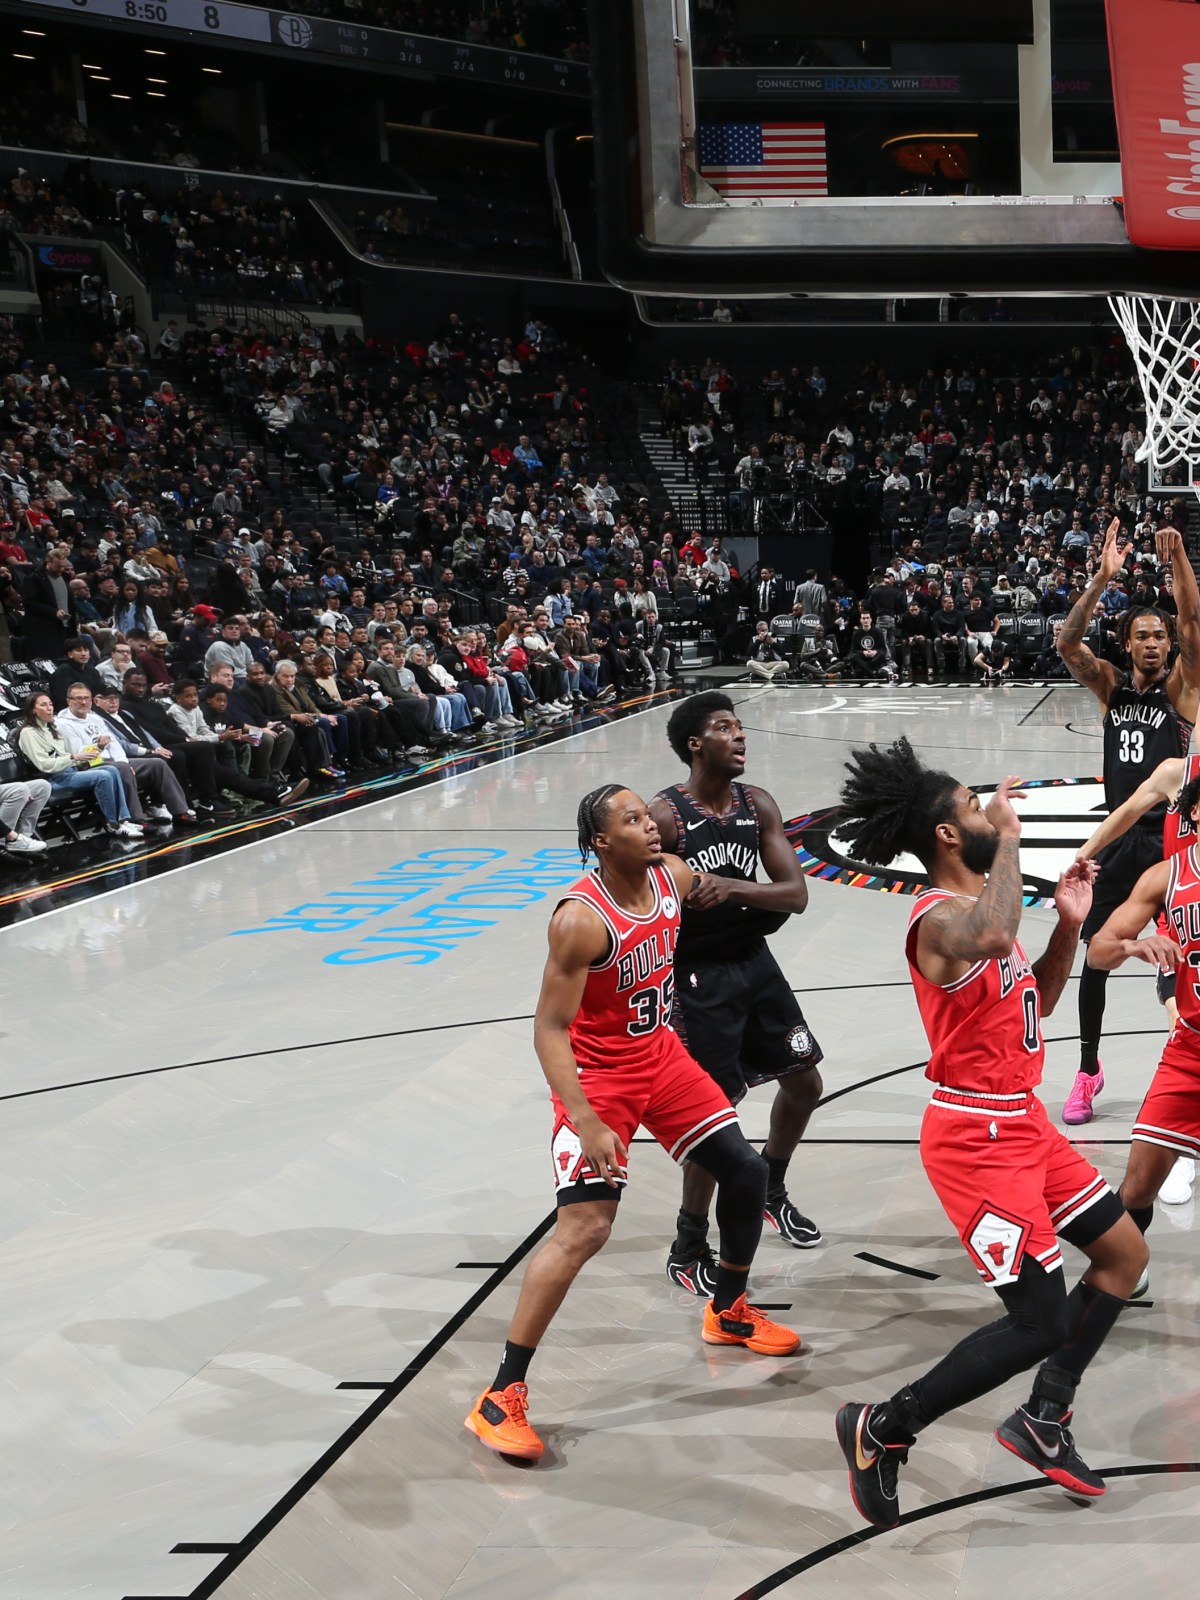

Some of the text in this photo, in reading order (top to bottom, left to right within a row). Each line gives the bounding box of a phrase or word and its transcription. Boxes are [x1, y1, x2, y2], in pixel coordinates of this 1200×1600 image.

[125, 0, 220, 29] 8:50 8
[361, 31, 368, 41] 0
[362, 47, 369, 56] 7
[757, 77, 960, 91] CONNECTING BRANDS WITH FANS
[1119, 729, 1145, 763] 33
[686, 842, 755, 877] BROOKLYN
[229, 847, 508, 936] CENTER
[627, 967, 674, 1037] 35
[1022, 987, 1040, 1053] 0
